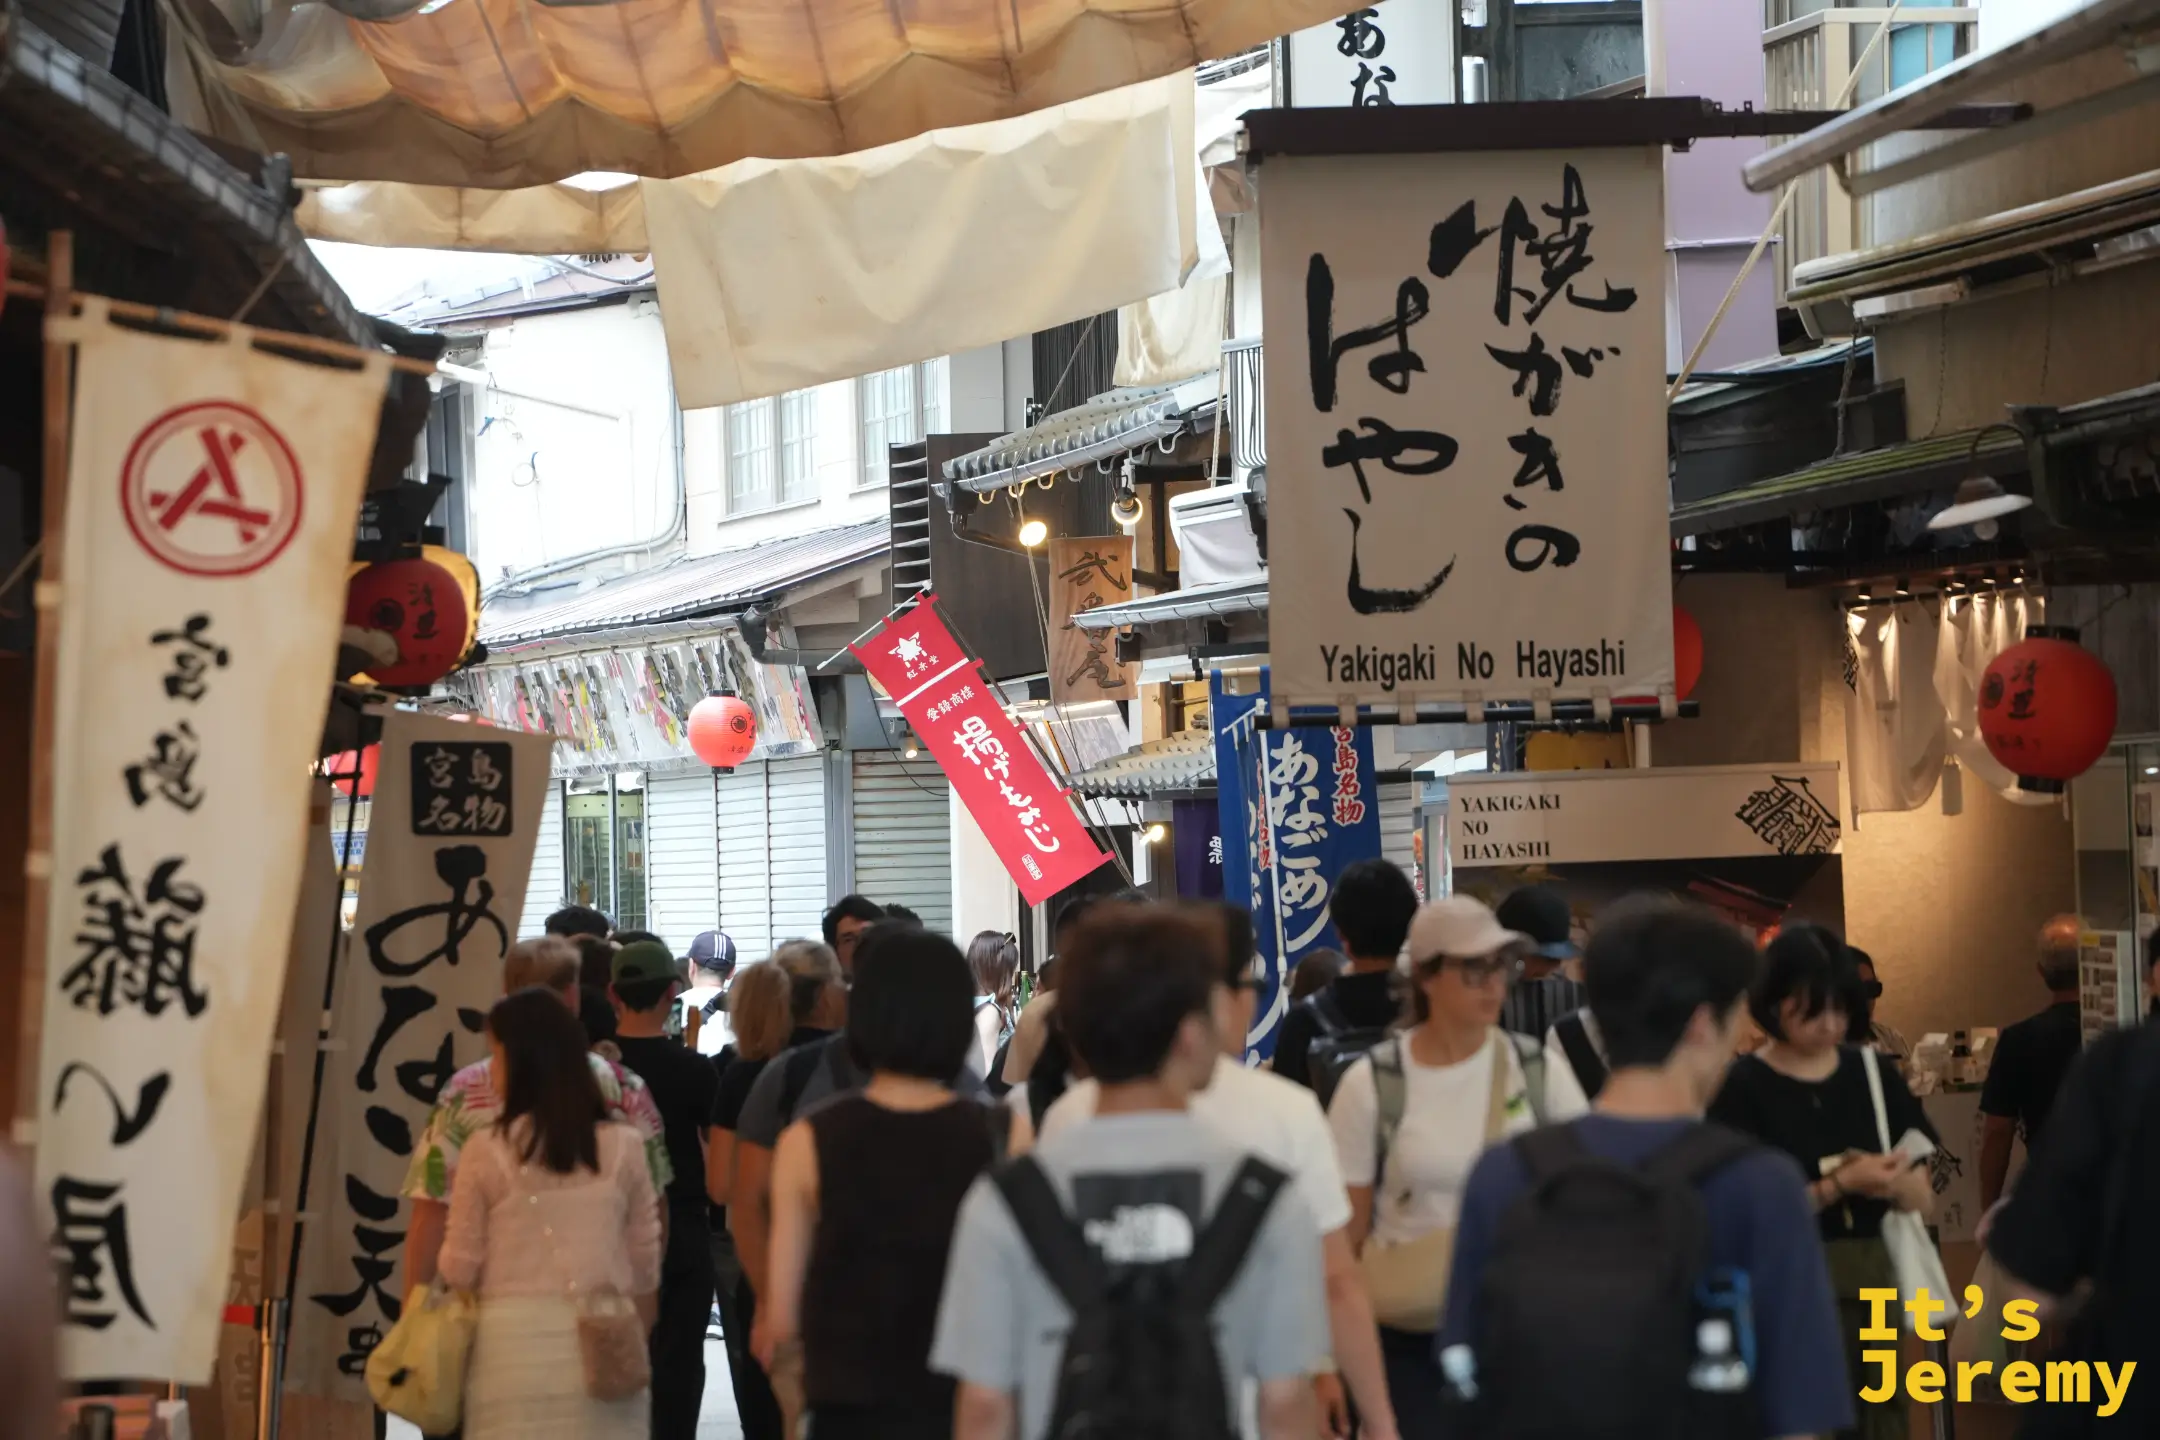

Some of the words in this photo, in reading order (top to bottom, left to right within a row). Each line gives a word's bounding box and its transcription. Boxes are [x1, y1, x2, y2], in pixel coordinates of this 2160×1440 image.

[1428, 163, 1638, 573] 焼がきの
[1306, 252, 1459, 615] はやし
[1319, 643, 1436, 693] Yakigaki
[1457, 641, 1495, 681] No
[1516, 637, 1626, 690] Hayashi
[926, 685, 975, 722] 登録商標
[952, 715, 1061, 853] 揚げもみじ
[1460, 793, 1562, 814] YAKIGAKI
[1461, 820, 1489, 836] NO
[1462, 840, 1551, 860] HAYASHI
